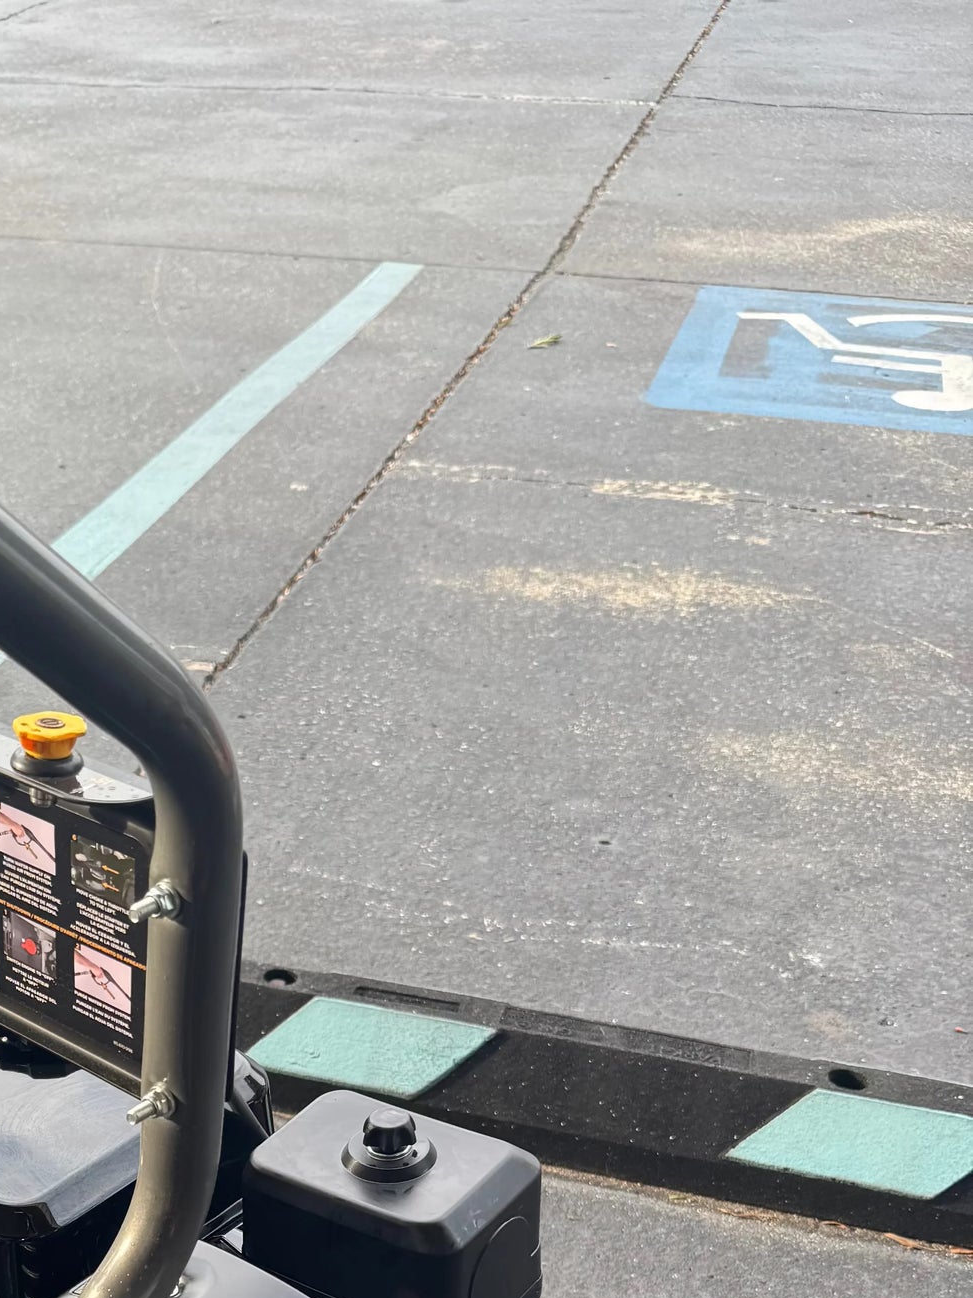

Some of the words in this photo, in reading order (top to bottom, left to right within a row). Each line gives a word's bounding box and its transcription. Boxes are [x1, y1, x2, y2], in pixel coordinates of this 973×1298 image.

[76, 888, 88, 898] MOVE
[89, 893, 104, 904] CHOKE
[96, 903, 104, 911] THE
